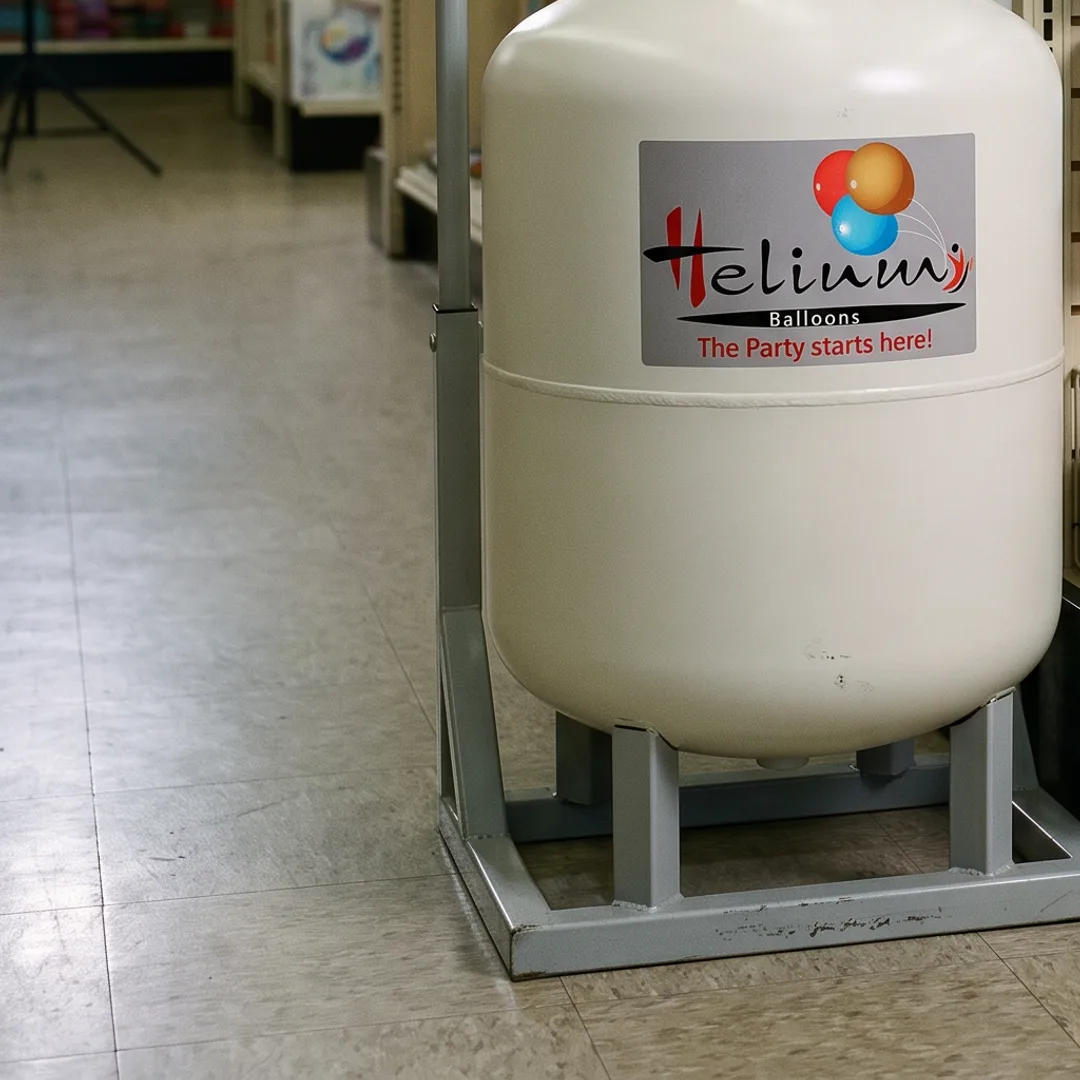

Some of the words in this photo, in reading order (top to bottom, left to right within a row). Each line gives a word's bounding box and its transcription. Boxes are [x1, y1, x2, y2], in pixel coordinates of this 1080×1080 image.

[769, 310, 860, 327] Balloons
[698, 337, 739, 359] The
[747, 337, 805, 362] Party
[811, 334, 873, 356] starts
[880, 328, 932, 352] here!
